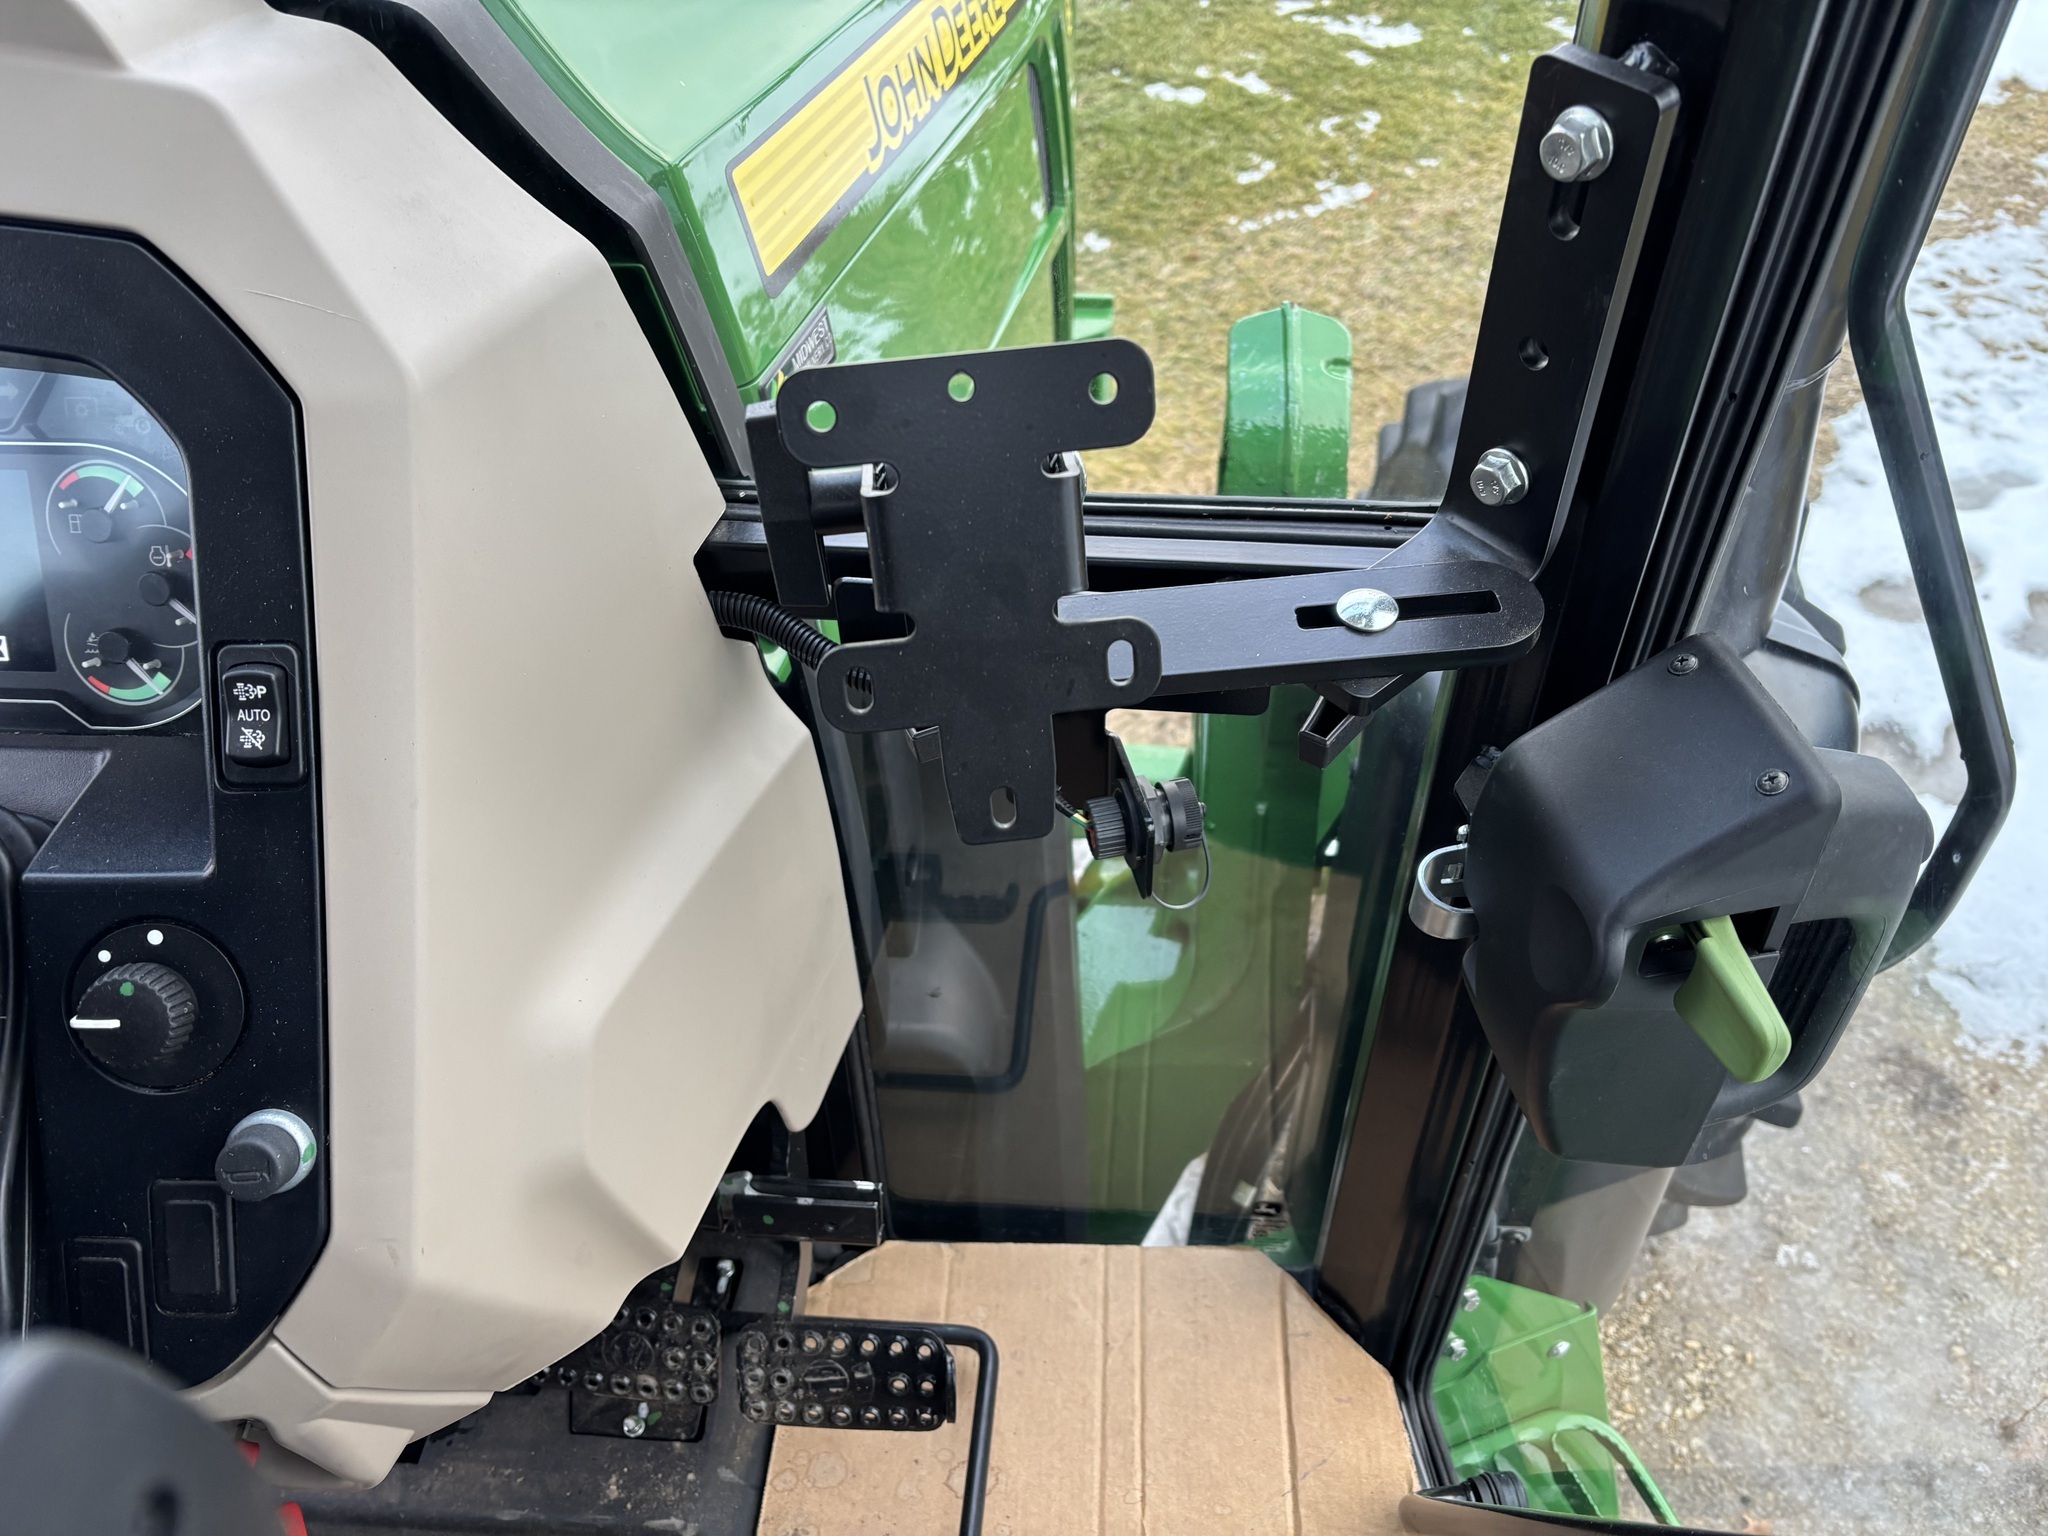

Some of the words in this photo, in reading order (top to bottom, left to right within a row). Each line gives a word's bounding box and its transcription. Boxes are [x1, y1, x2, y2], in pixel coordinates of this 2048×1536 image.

[862, 34, 940, 164] JOHN
[792, 314, 829, 368] MIDWEST
[237, 708, 271, 722] AUTO
